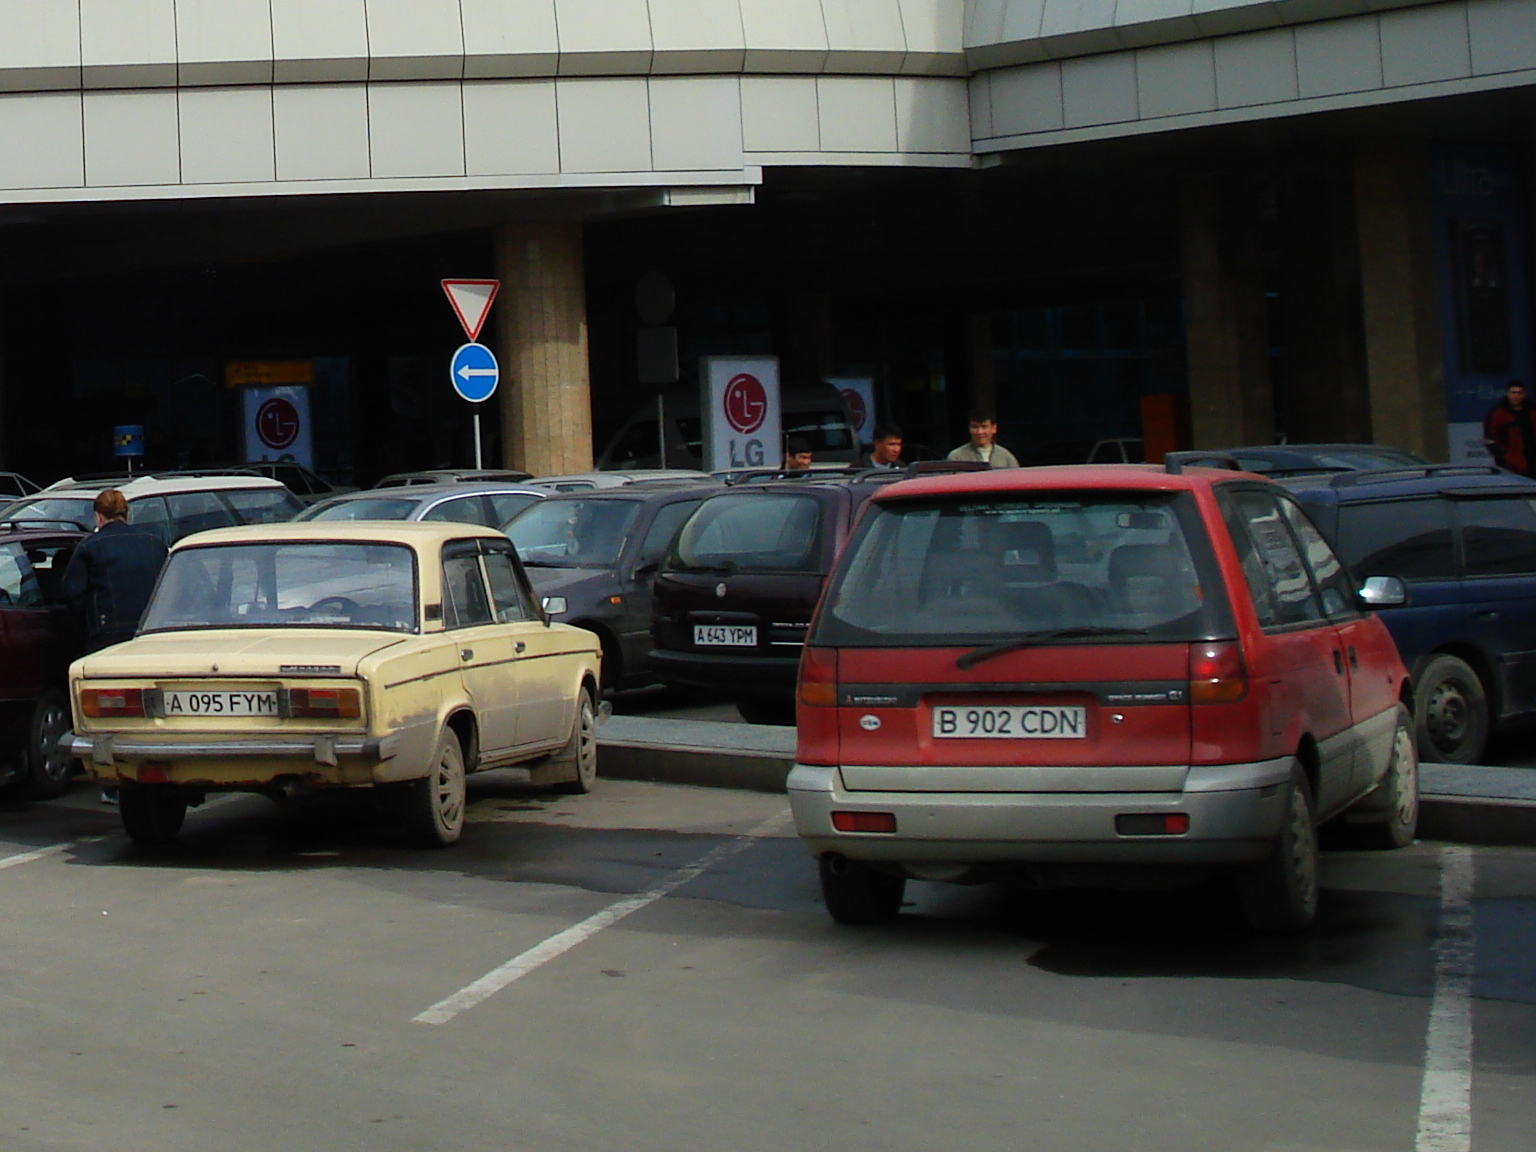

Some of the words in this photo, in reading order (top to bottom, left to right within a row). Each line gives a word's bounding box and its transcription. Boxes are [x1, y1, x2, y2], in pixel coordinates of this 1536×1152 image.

[728, 438, 765, 467] LG
[697, 628, 705, 642] A
[729, 629, 754, 644] YPM
[170, 693, 184, 713] A
[189, 693, 224, 713] 095
[229, 693, 273, 713] FYM
[940, 709, 957, 734] B
[966, 709, 1012, 734] 902
[1021, 709, 1079, 734] CDN
